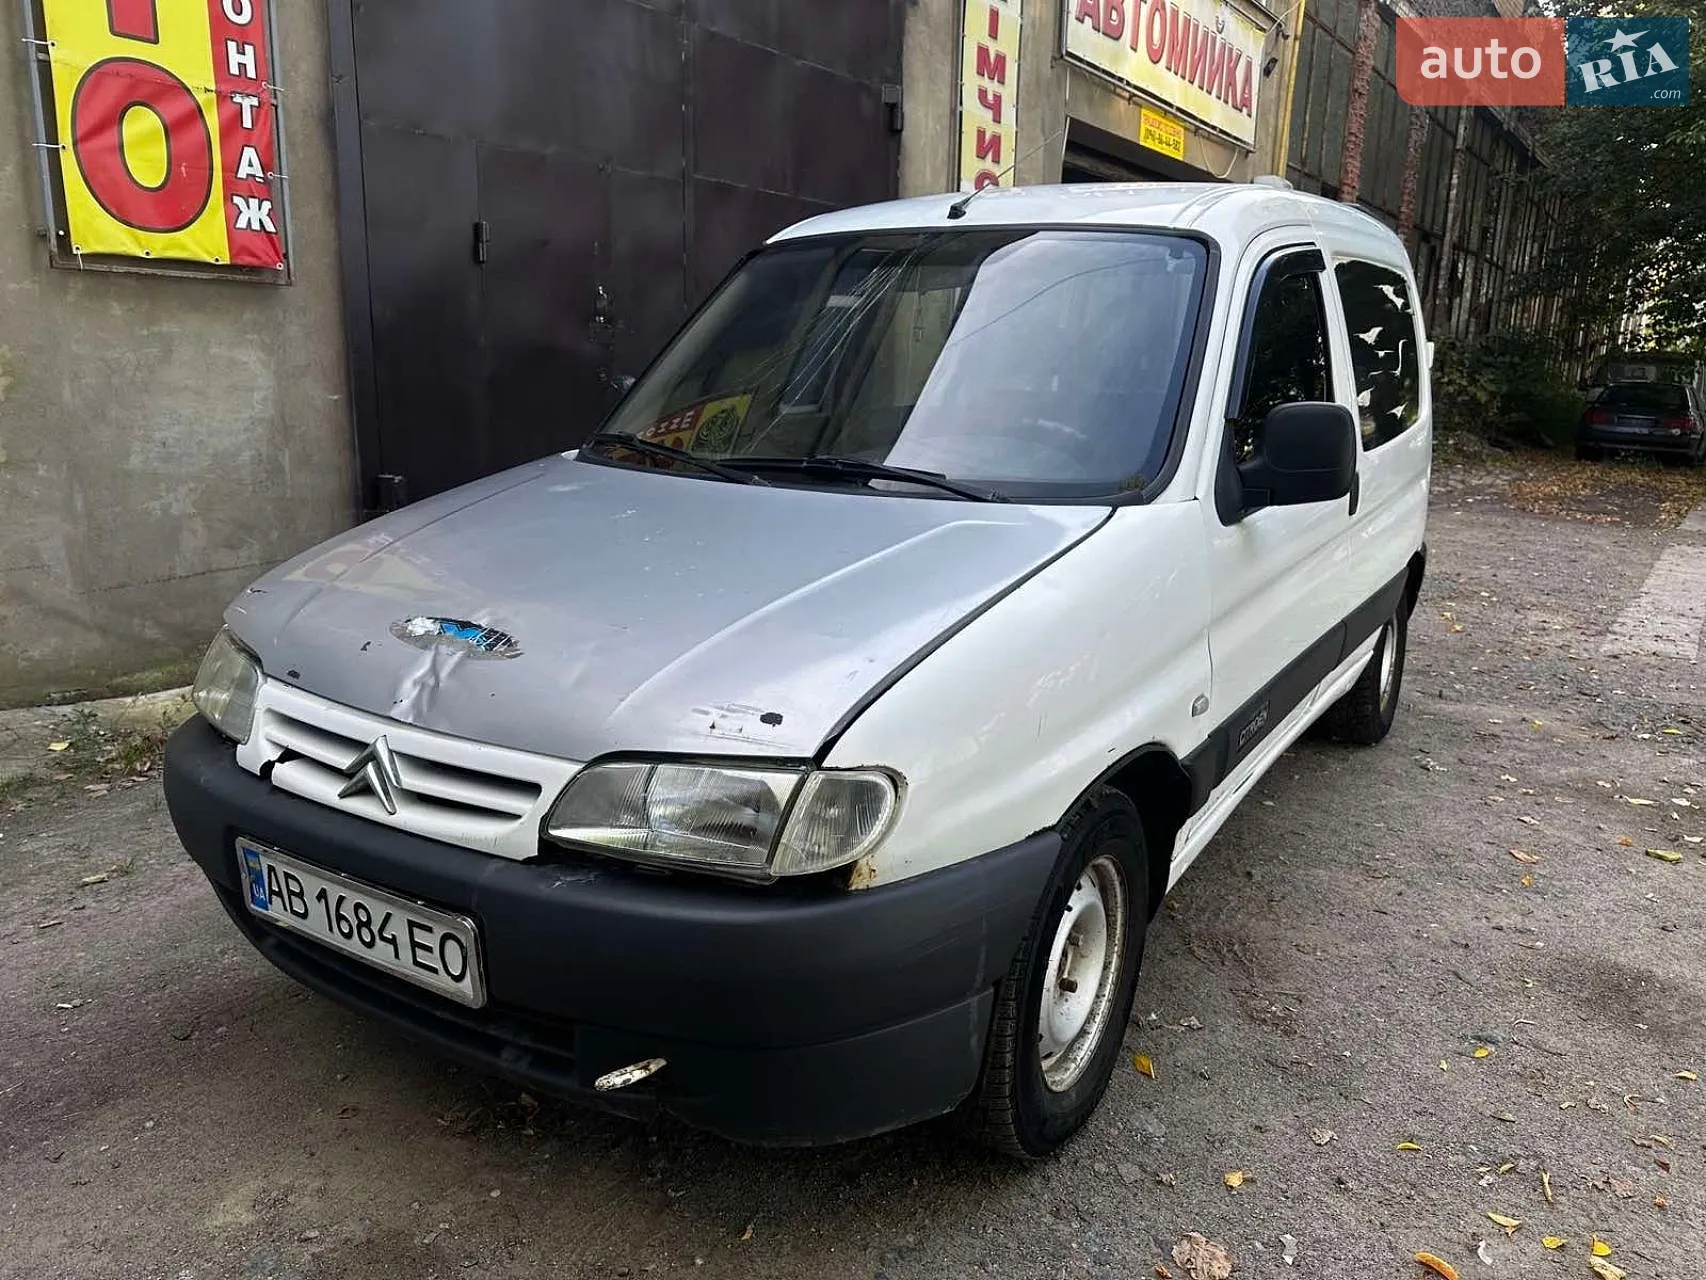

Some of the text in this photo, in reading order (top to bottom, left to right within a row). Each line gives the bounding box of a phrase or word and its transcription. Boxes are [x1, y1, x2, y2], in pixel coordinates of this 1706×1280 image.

[974, 0, 1007, 190] ІМЧИС
[252, 882, 266, 902] UA
[266, 863, 309, 920] AB
[315, 886, 401, 960] 1684
